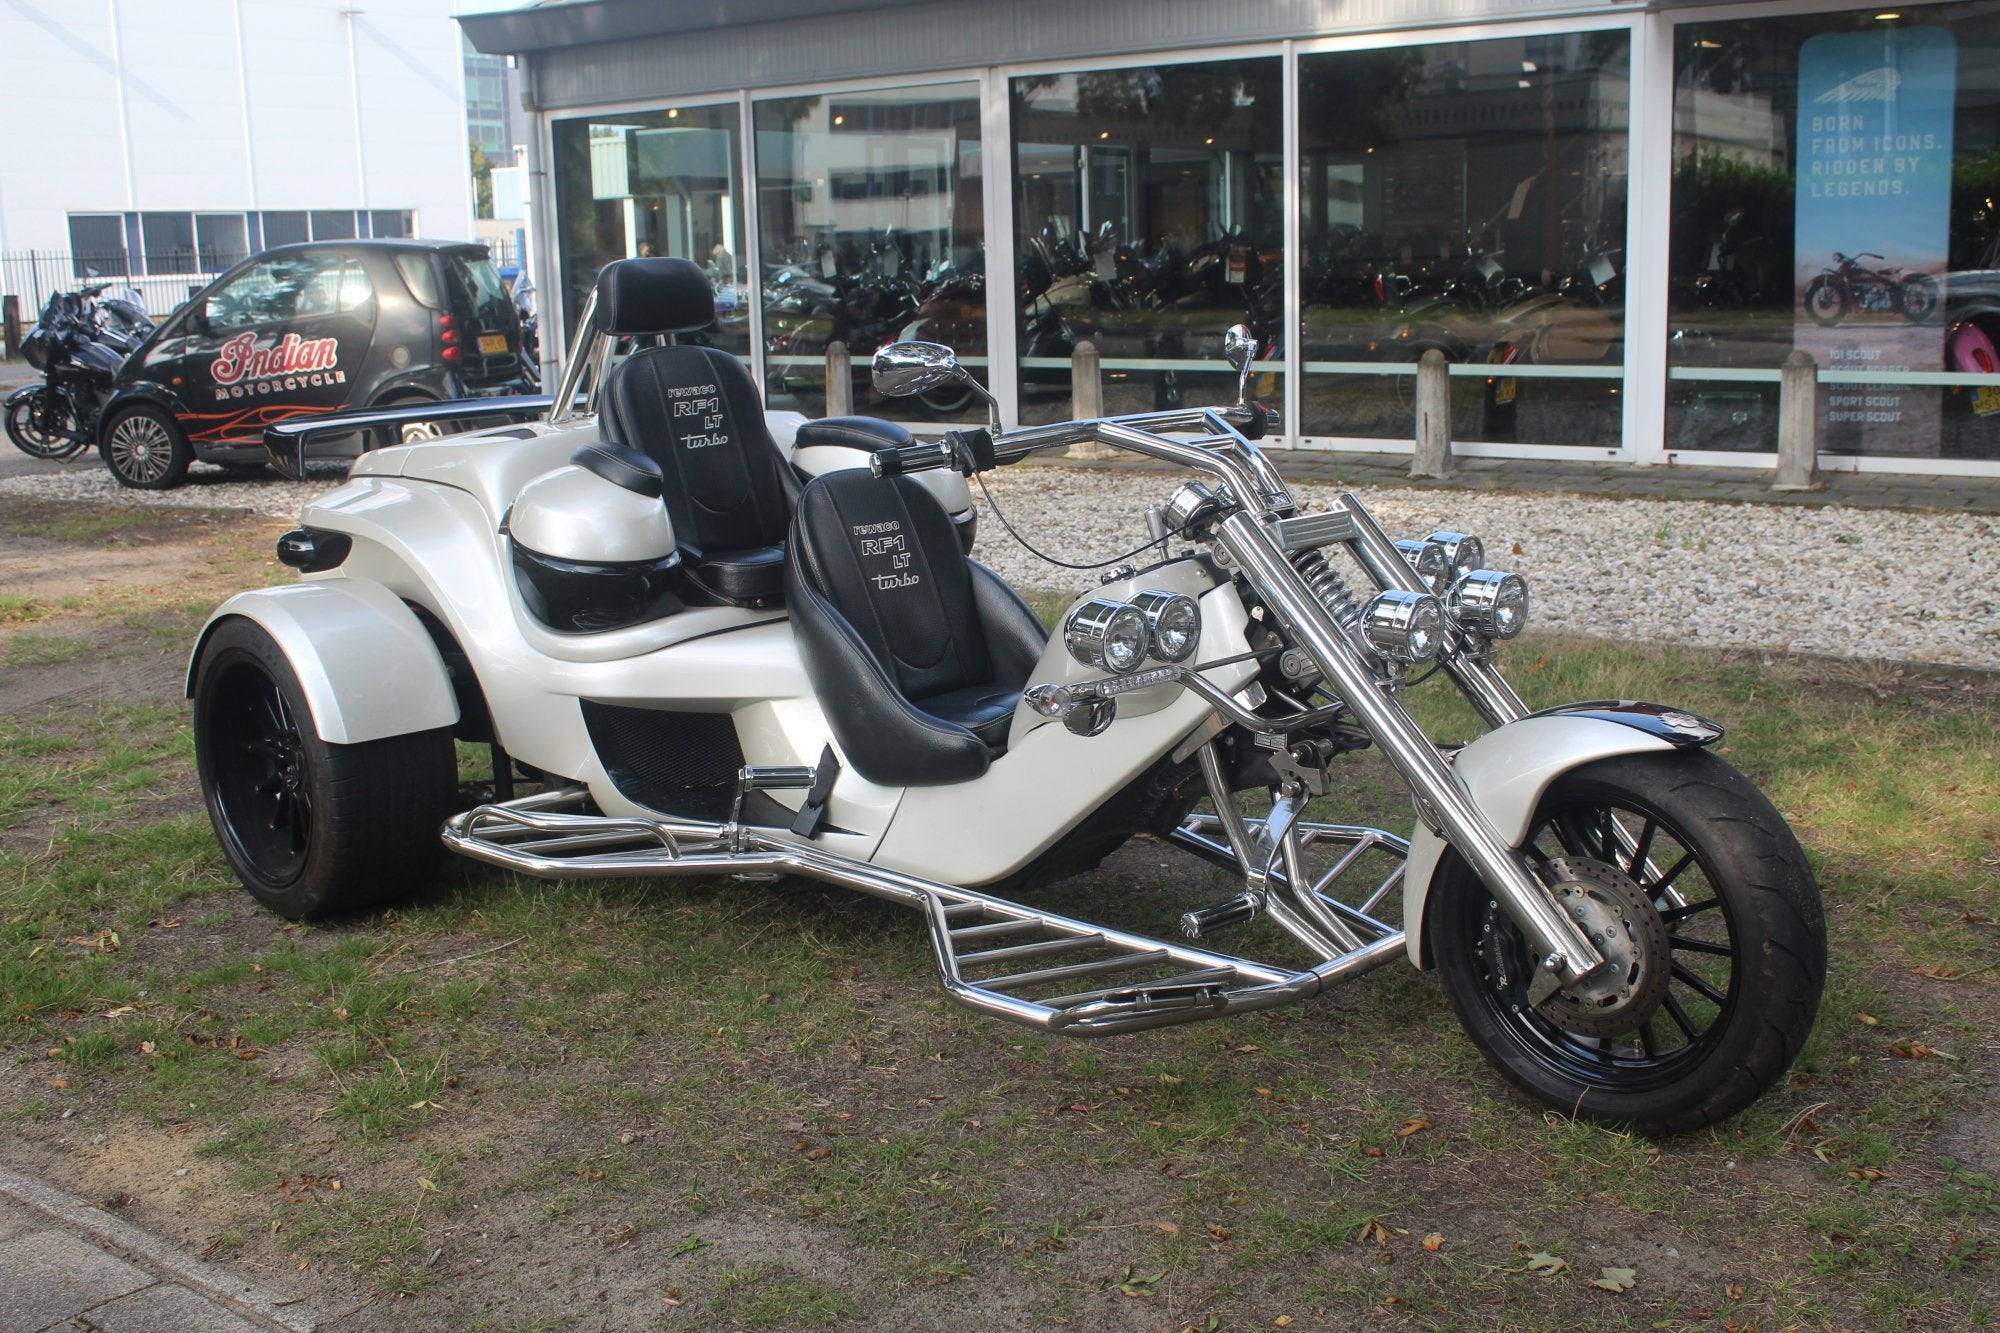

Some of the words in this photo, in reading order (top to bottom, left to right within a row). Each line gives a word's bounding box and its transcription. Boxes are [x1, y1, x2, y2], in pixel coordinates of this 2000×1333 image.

[1812, 115, 1864, 132] BORN
[1812, 137, 1864, 154] FROM
[1874, 134, 1943, 153] ICONS.
[1812, 158, 1884, 176] RIDDEN
[1894, 156, 1921, 174] BY
[1811, 179, 1911, 198] LEGENDS.
[211, 331, 338, 385] Indian
[1846, 349, 1881, 360] SCOUT
[215, 370, 347, 401] MOTORCYCLE
[667, 384, 716, 398] rewaco
[673, 397, 719, 417] RF1
[1829, 396, 1863, 407] SPORT
[1865, 396, 1901, 407] SCOUT
[704, 414, 723, 430] LT
[1829, 411, 1865, 422] SUPER
[1866, 411, 1902, 422] SCOUT
[680, 433, 728, 449] turbo
[853, 521, 900, 536] rewaco
[861, 534, 905, 556] RF1
[892, 552, 911, 570] LT
[871, 572, 920, 590] turbo
